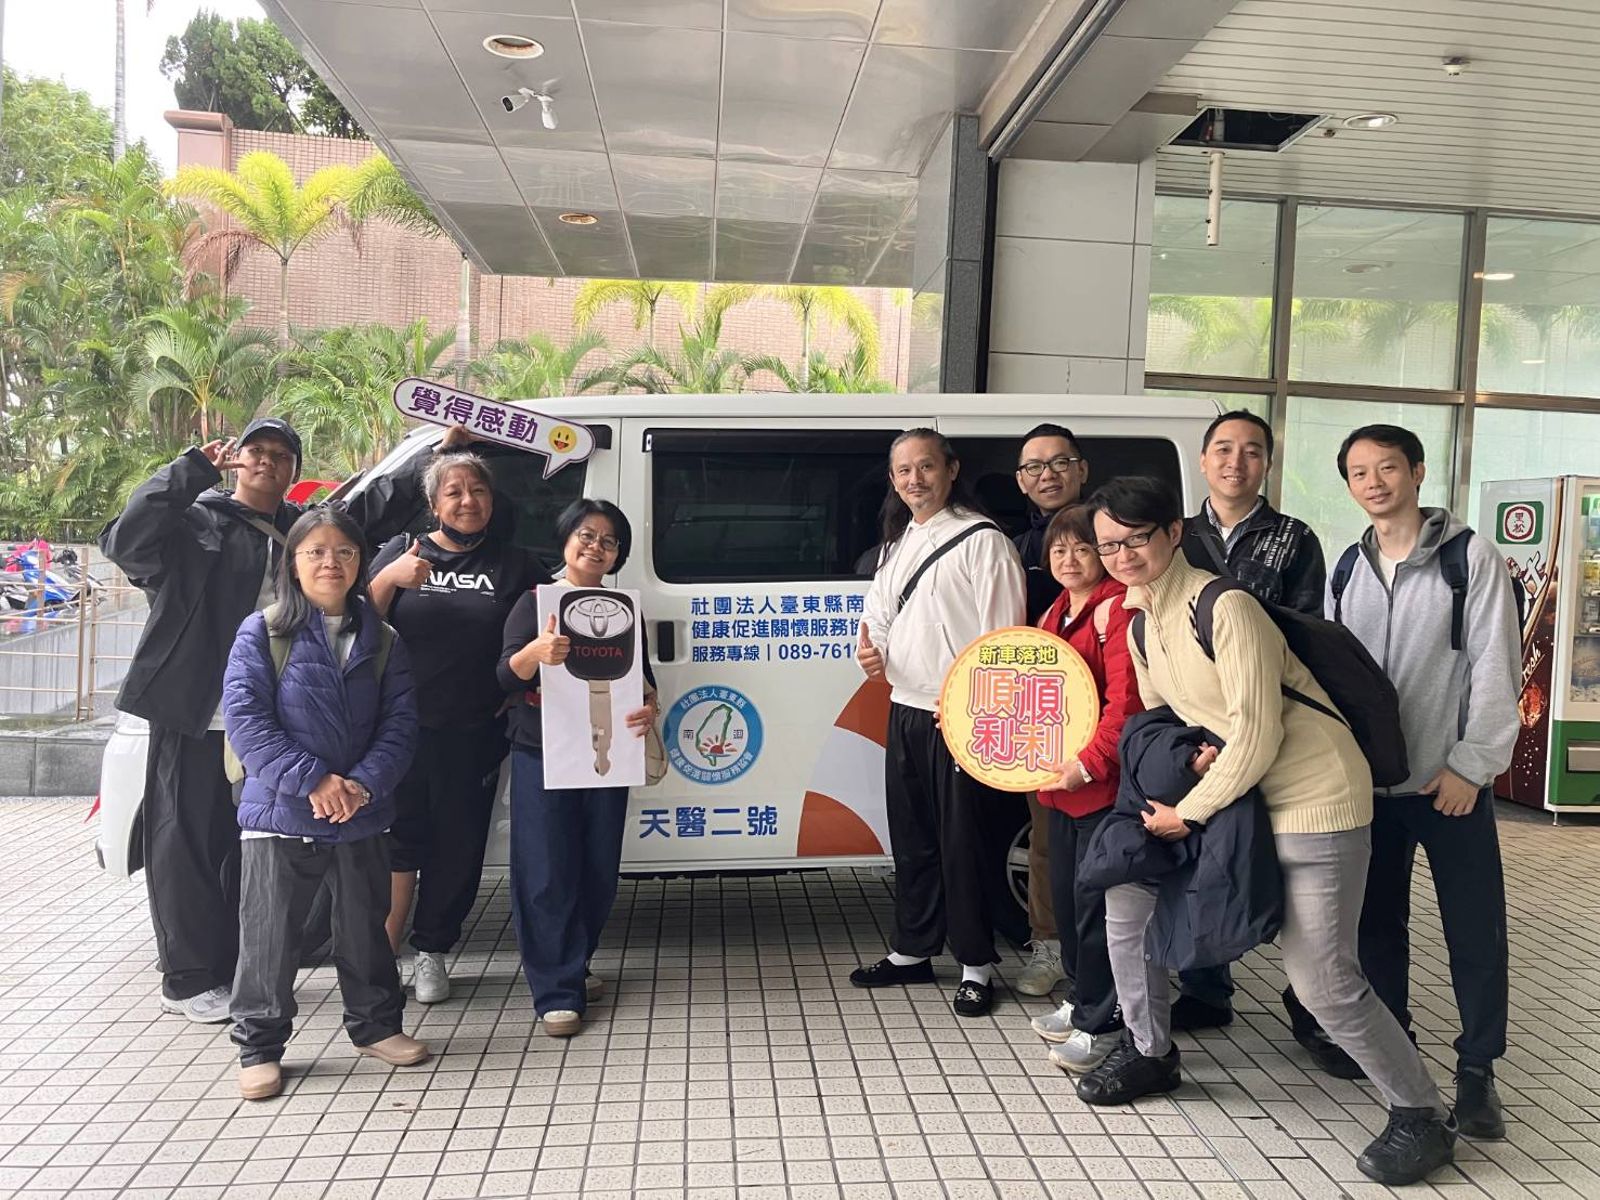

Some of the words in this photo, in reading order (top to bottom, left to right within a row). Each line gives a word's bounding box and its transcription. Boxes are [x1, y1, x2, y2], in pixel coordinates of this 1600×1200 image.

[408, 386, 538, 443] 覺得感動
[691, 595, 864, 615] 社團法人臺東縣南
[575, 645, 624, 658] TOYOTA
[691, 645, 760, 663] 服務專線
[778, 643, 857, 661] 089-761
[979, 644, 1058, 665] 新車落地
[639, 805, 778, 838] 天醫二號
